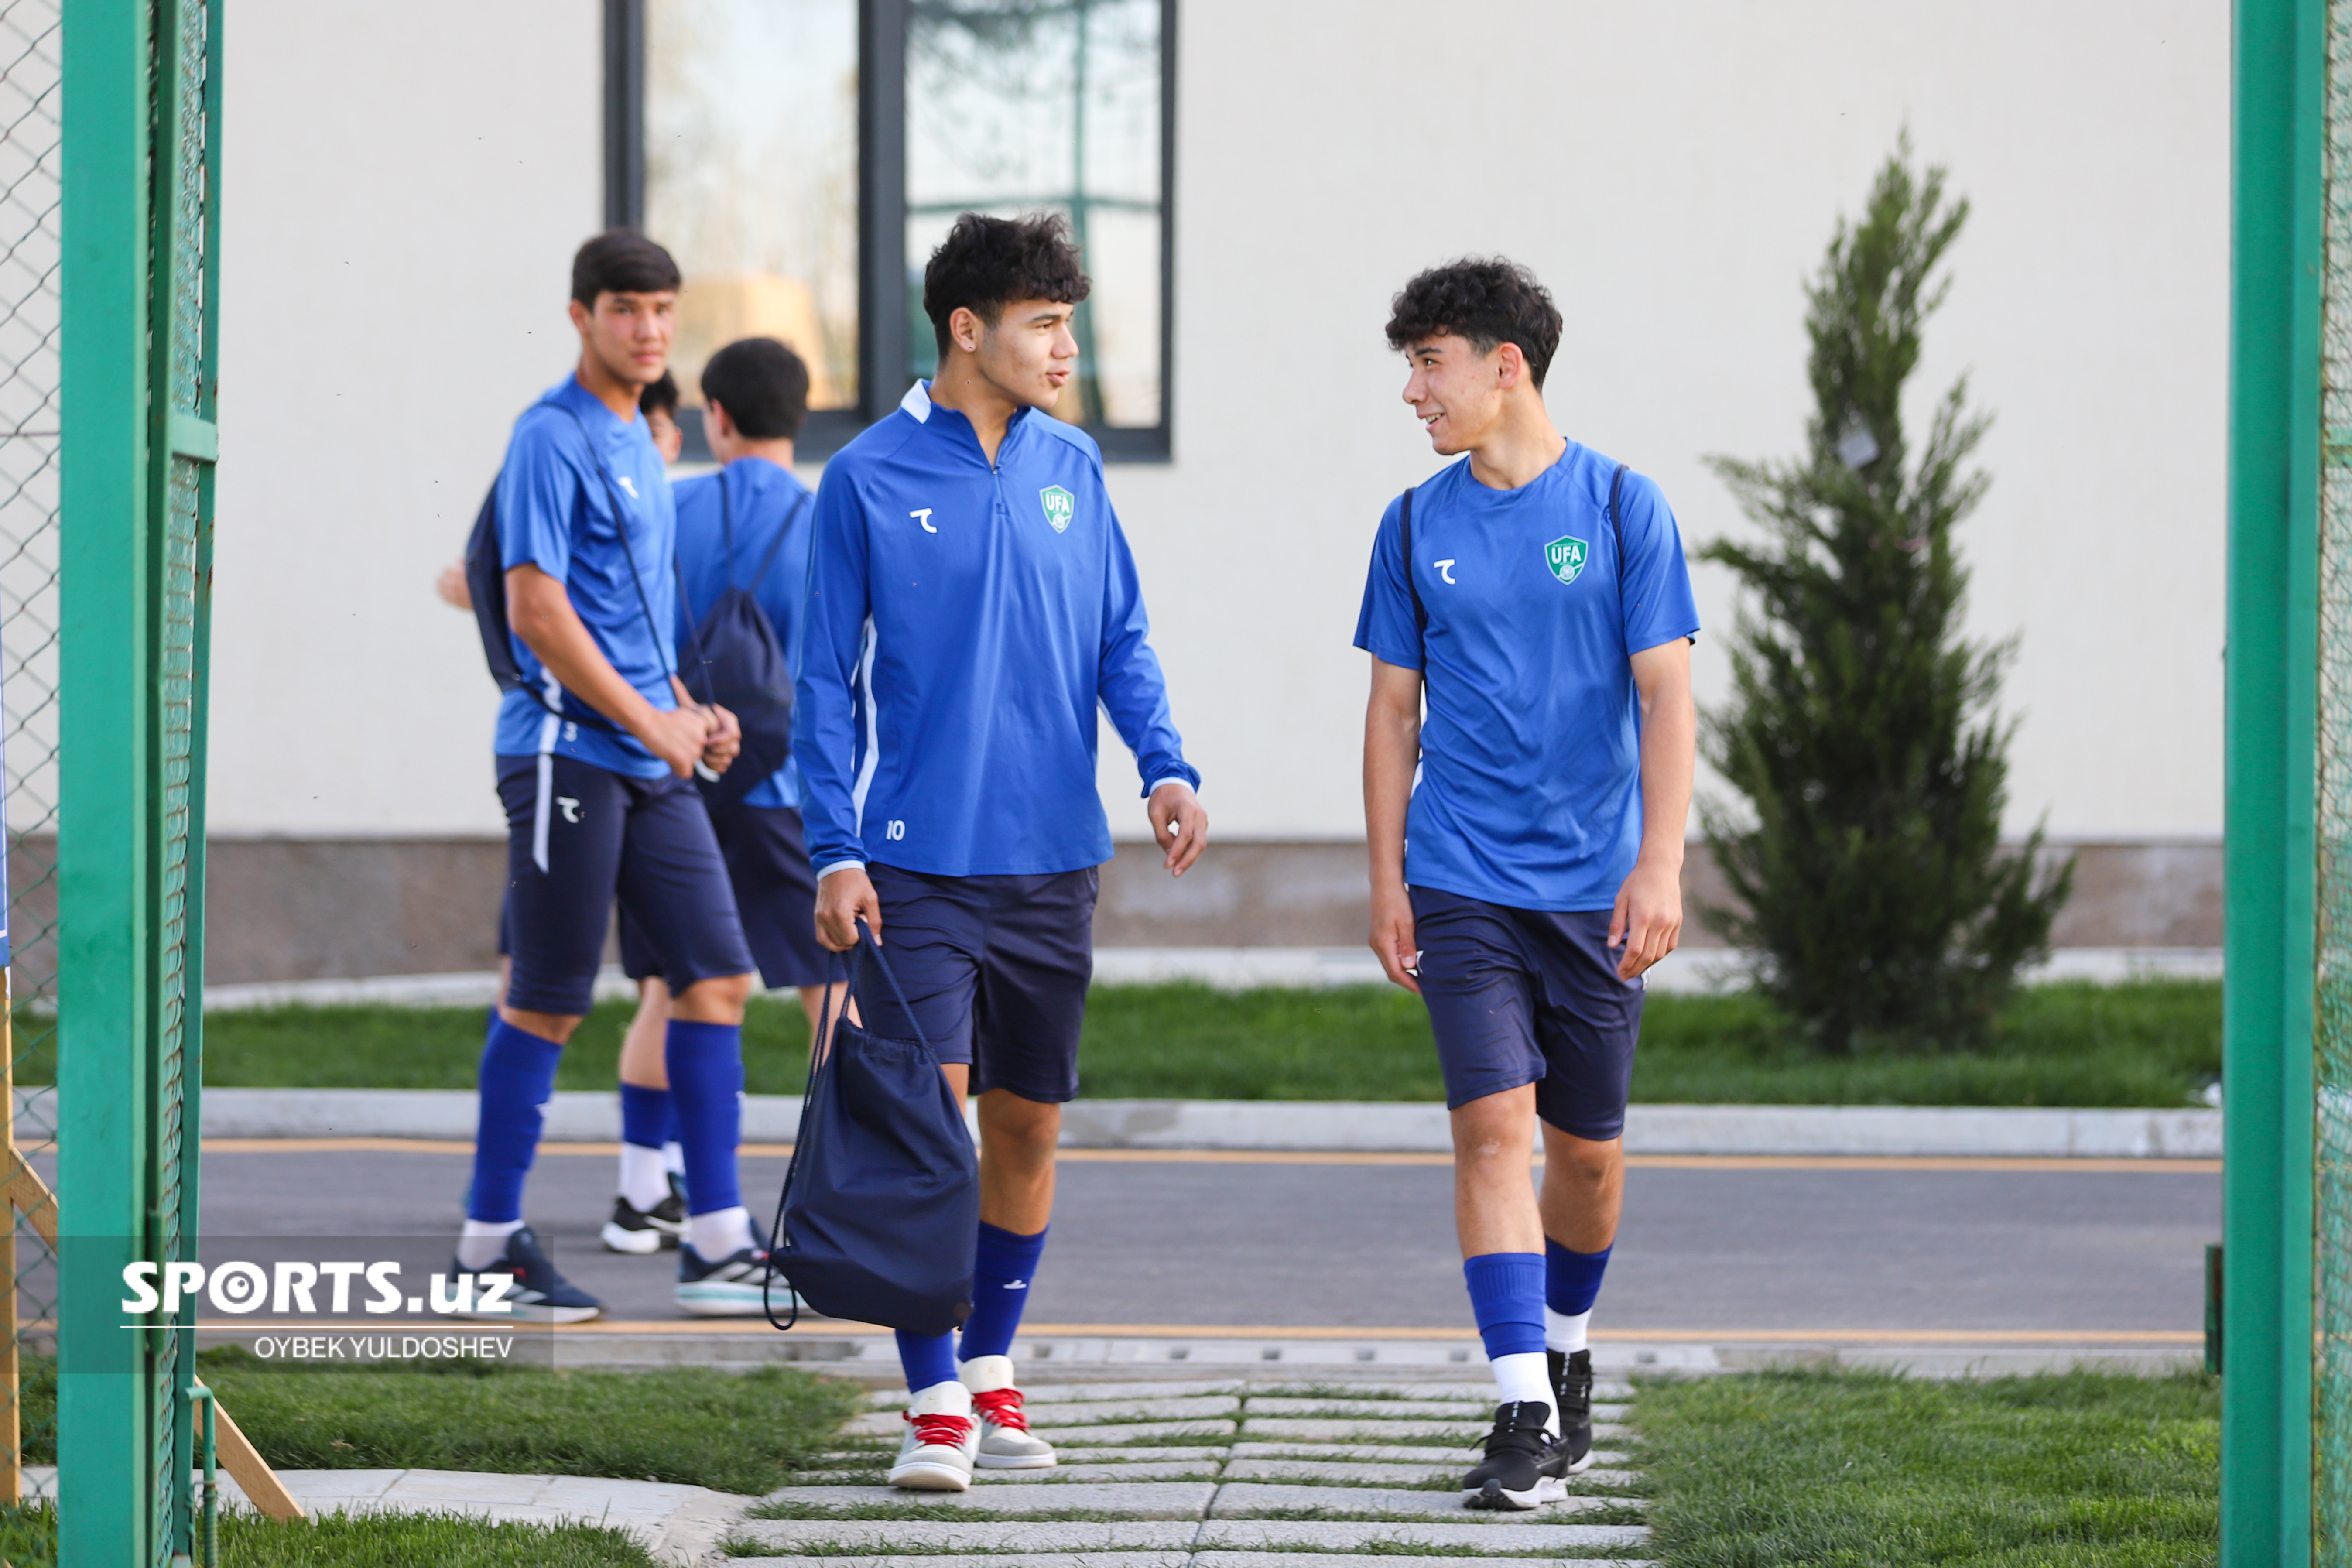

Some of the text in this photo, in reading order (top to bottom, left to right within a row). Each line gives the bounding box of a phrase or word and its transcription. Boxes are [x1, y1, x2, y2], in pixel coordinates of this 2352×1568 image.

[1045, 494, 1070, 514] UFA
[1551, 545, 1582, 564] UFA
[886, 820, 905, 841] 10
